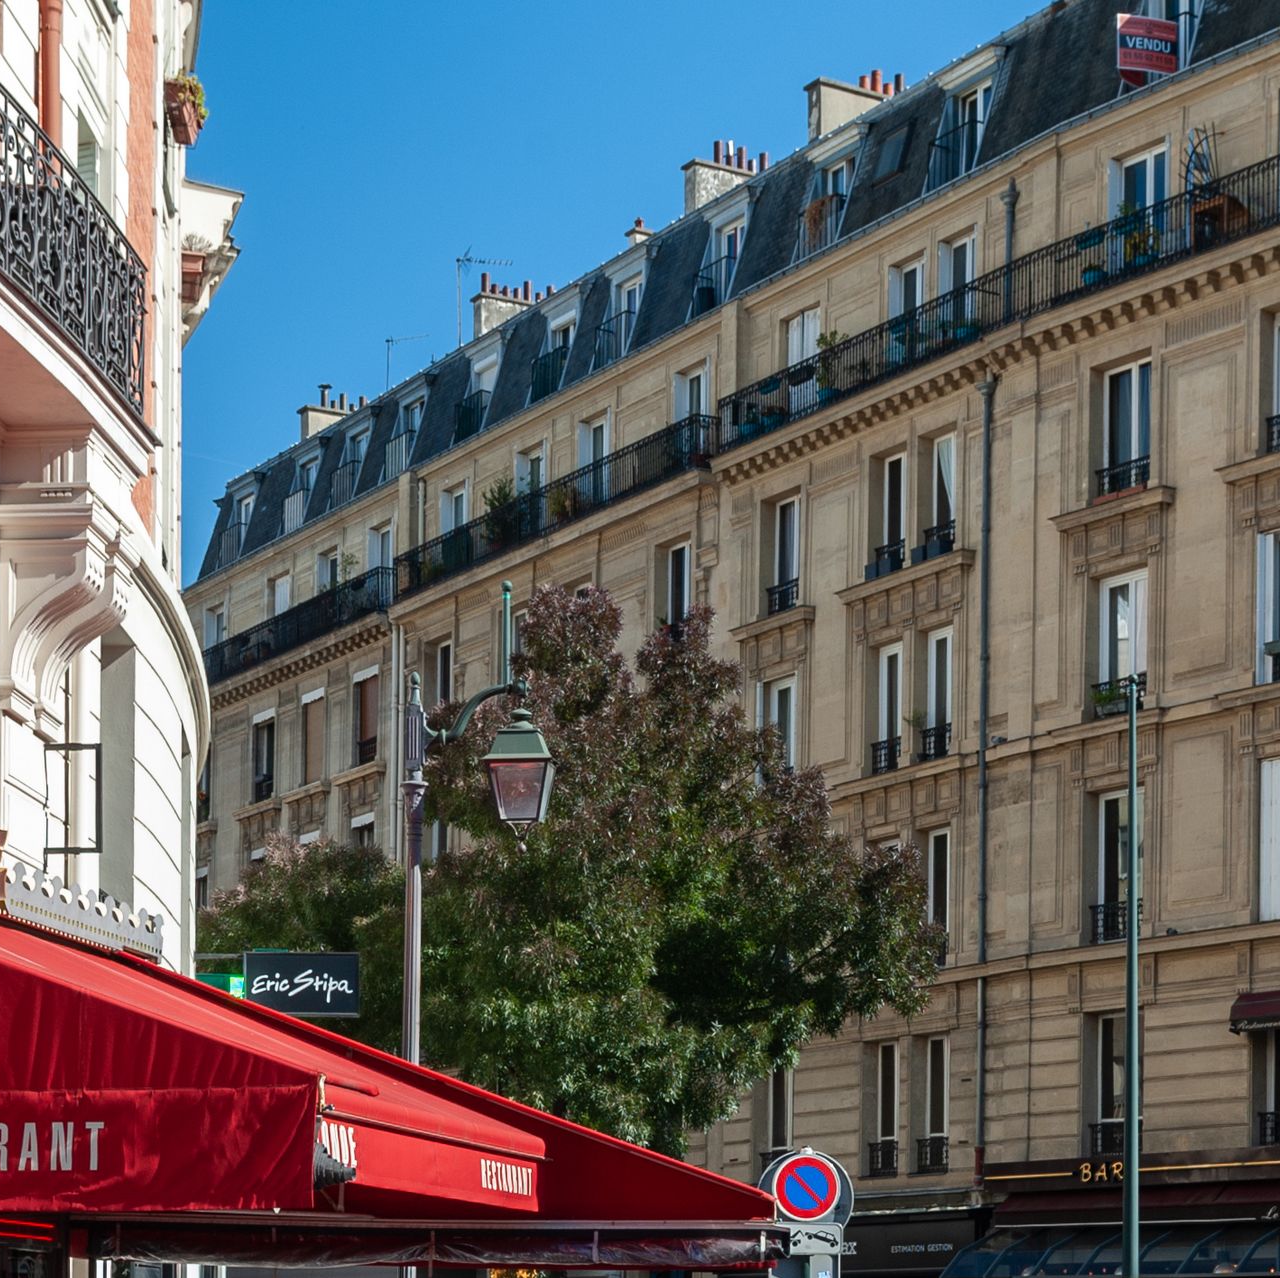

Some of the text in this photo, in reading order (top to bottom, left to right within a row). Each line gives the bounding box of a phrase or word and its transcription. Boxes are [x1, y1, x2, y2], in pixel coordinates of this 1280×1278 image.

[1125, 35, 1171, 54] VENDU
[250, 968, 354, 1003] Eric Stipa
[479, 1157, 533, 1197] RESTAURANT
[1079, 1161, 1124, 1183] BAR
[1260, 1206, 1279, 1220] Le
[890, 1243, 925, 1254] ESTIMATION
[926, 1242, 954, 1252] GESTION
